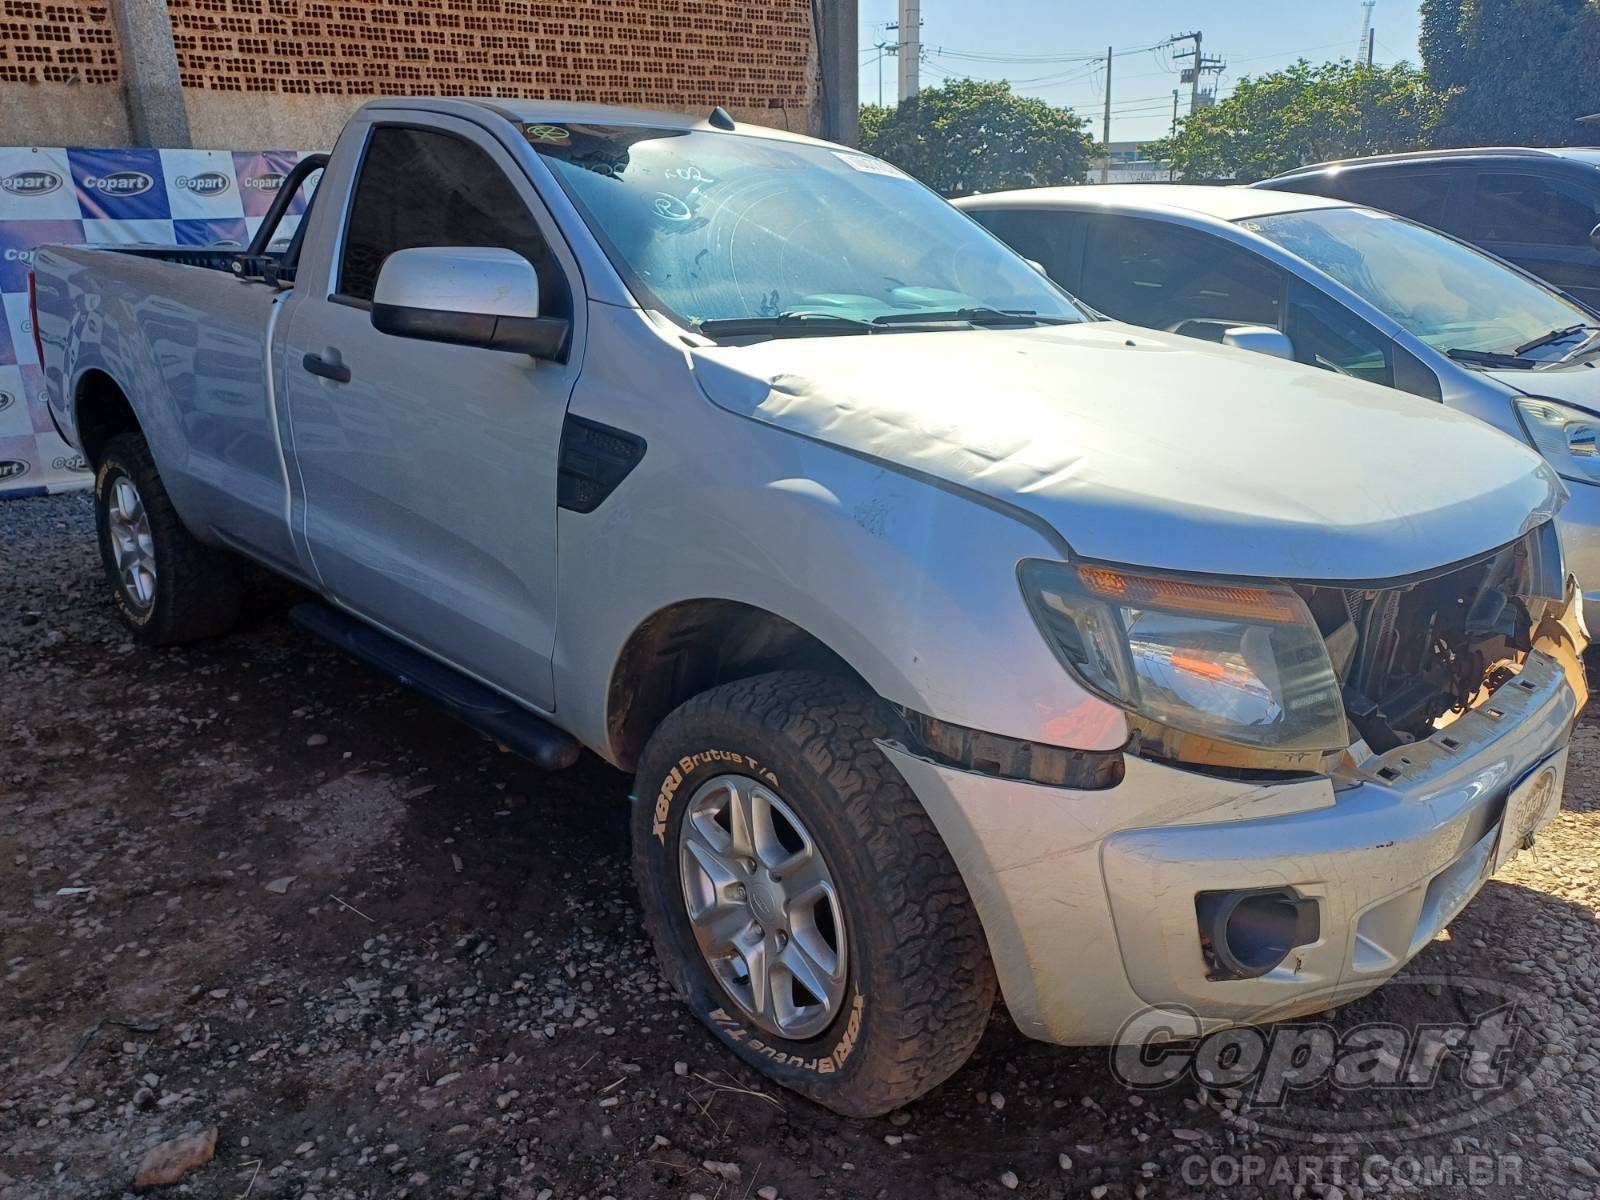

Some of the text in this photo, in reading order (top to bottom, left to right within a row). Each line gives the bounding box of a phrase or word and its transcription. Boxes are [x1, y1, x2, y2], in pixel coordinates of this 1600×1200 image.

[0, 175, 53, 189] opart
[83, 176, 145, 192] Copart
[175, 175, 224, 191] Copart
[653, 766, 682, 847] XBRI
[679, 749, 743, 774] Brutus
[749, 1039, 835, 1073] Brutus
